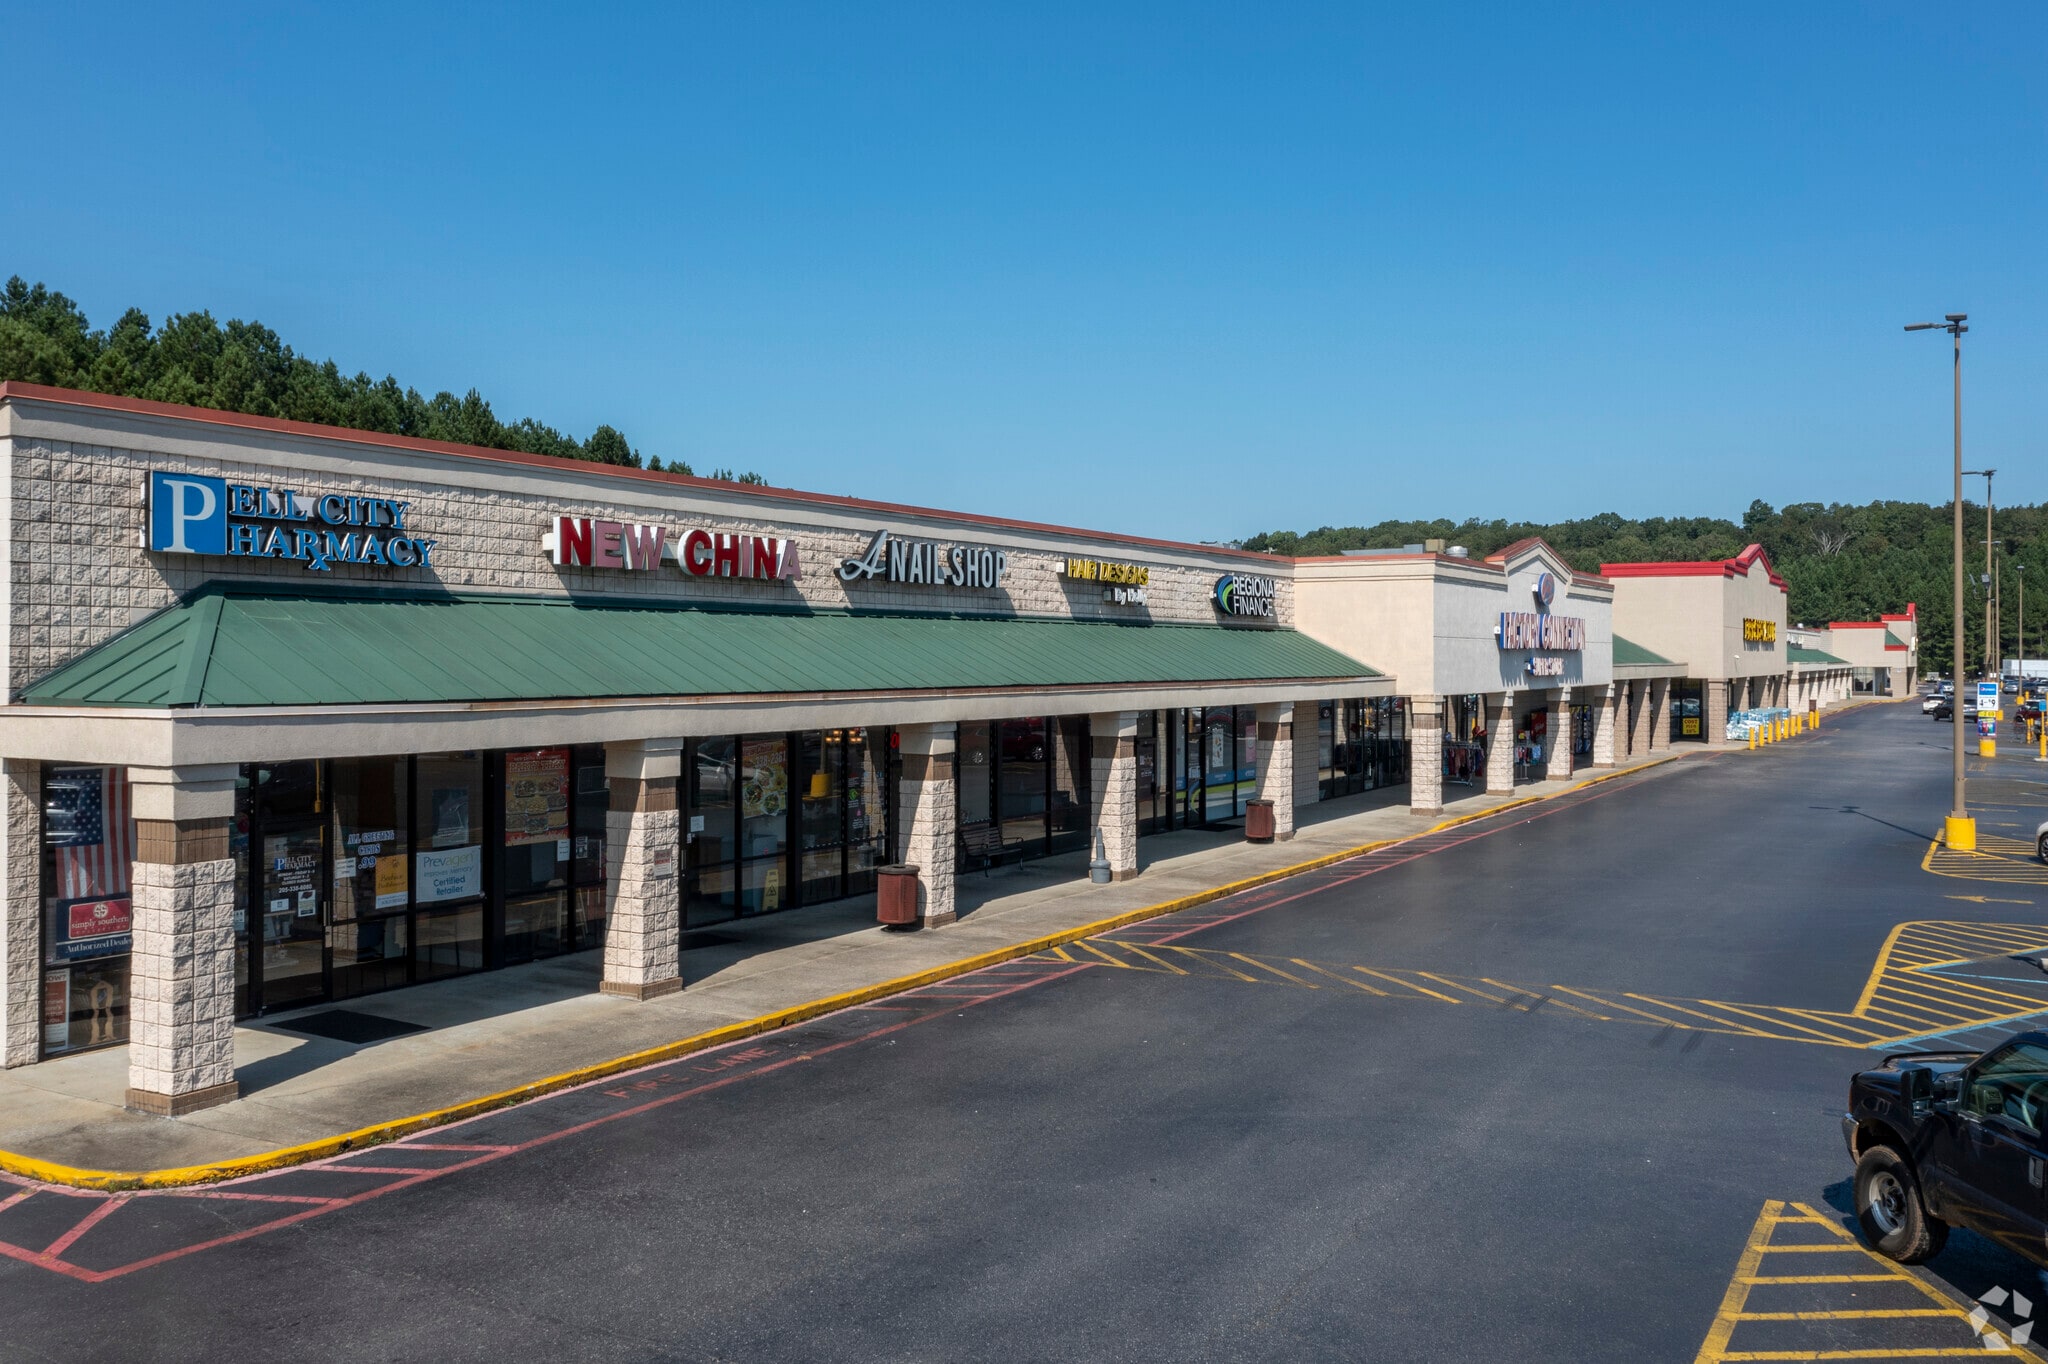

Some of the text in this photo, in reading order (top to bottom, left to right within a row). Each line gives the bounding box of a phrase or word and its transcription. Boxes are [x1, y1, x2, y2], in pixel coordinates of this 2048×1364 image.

[318, 494, 411, 530] CITY
[554, 516, 802, 581] NEW CHINA
[839, 529, 1007, 588] A NAIL SHOP
[1067, 558, 1149, 586] HAIR DESIGNS
[1114, 587, 1127, 605] By
[1232, 576, 1279, 598] REGIONAL
[1233, 596, 1274, 617] FINANCE
[358, 855, 377, 870] .99
[423, 852, 473, 868] Prevagen
[433, 875, 466, 887] Certified
[436, 886, 463, 896] Retailer
[71, 915, 129, 930] simply southern
[66, 938, 109, 954] Authorized
[603, 1046, 780, 1099] FIRE LANE
